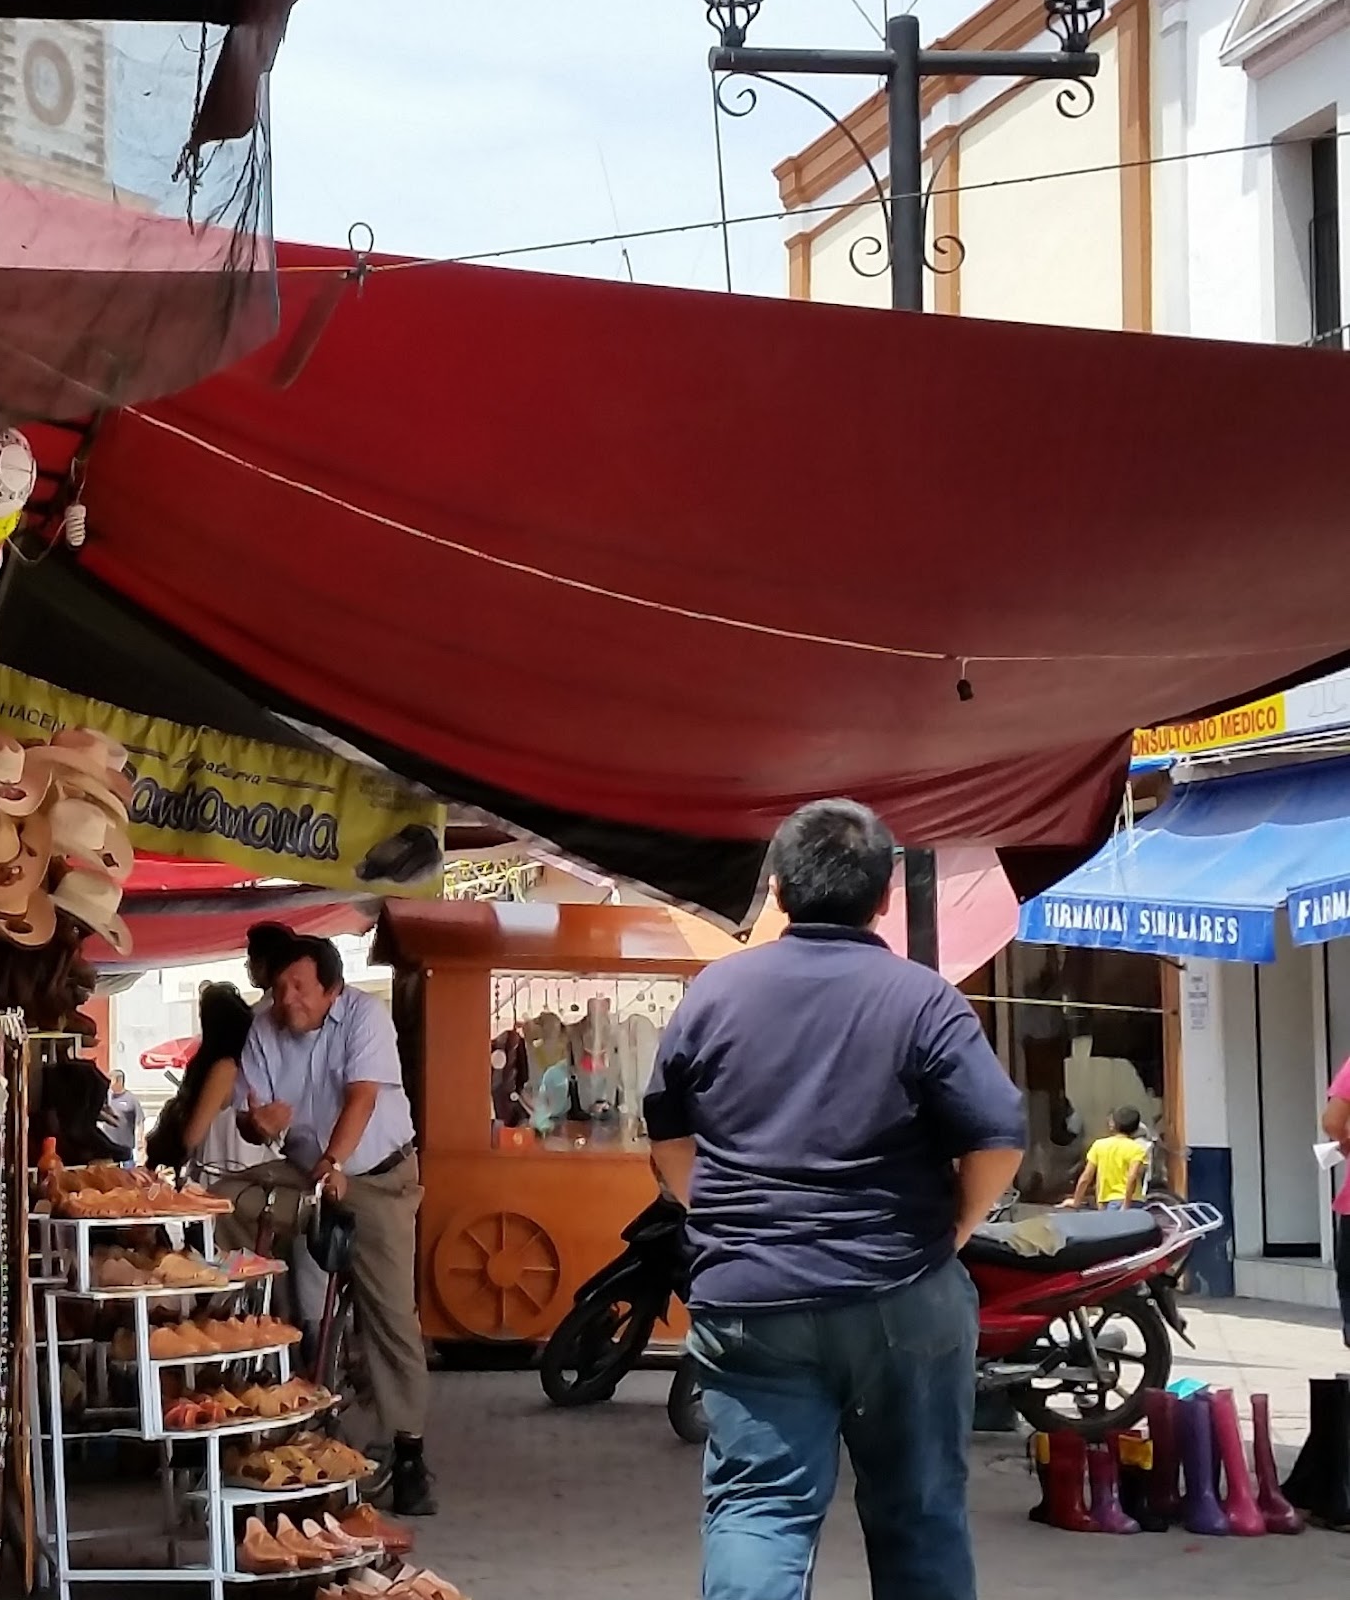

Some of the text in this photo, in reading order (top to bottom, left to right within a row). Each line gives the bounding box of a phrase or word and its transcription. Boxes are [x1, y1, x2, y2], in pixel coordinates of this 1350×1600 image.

[1132, 706, 1278, 756] ONSULTORIO MEDICO
[121, 761, 340, 862] antamaria
[1298, 889, 1350, 928] FARM
